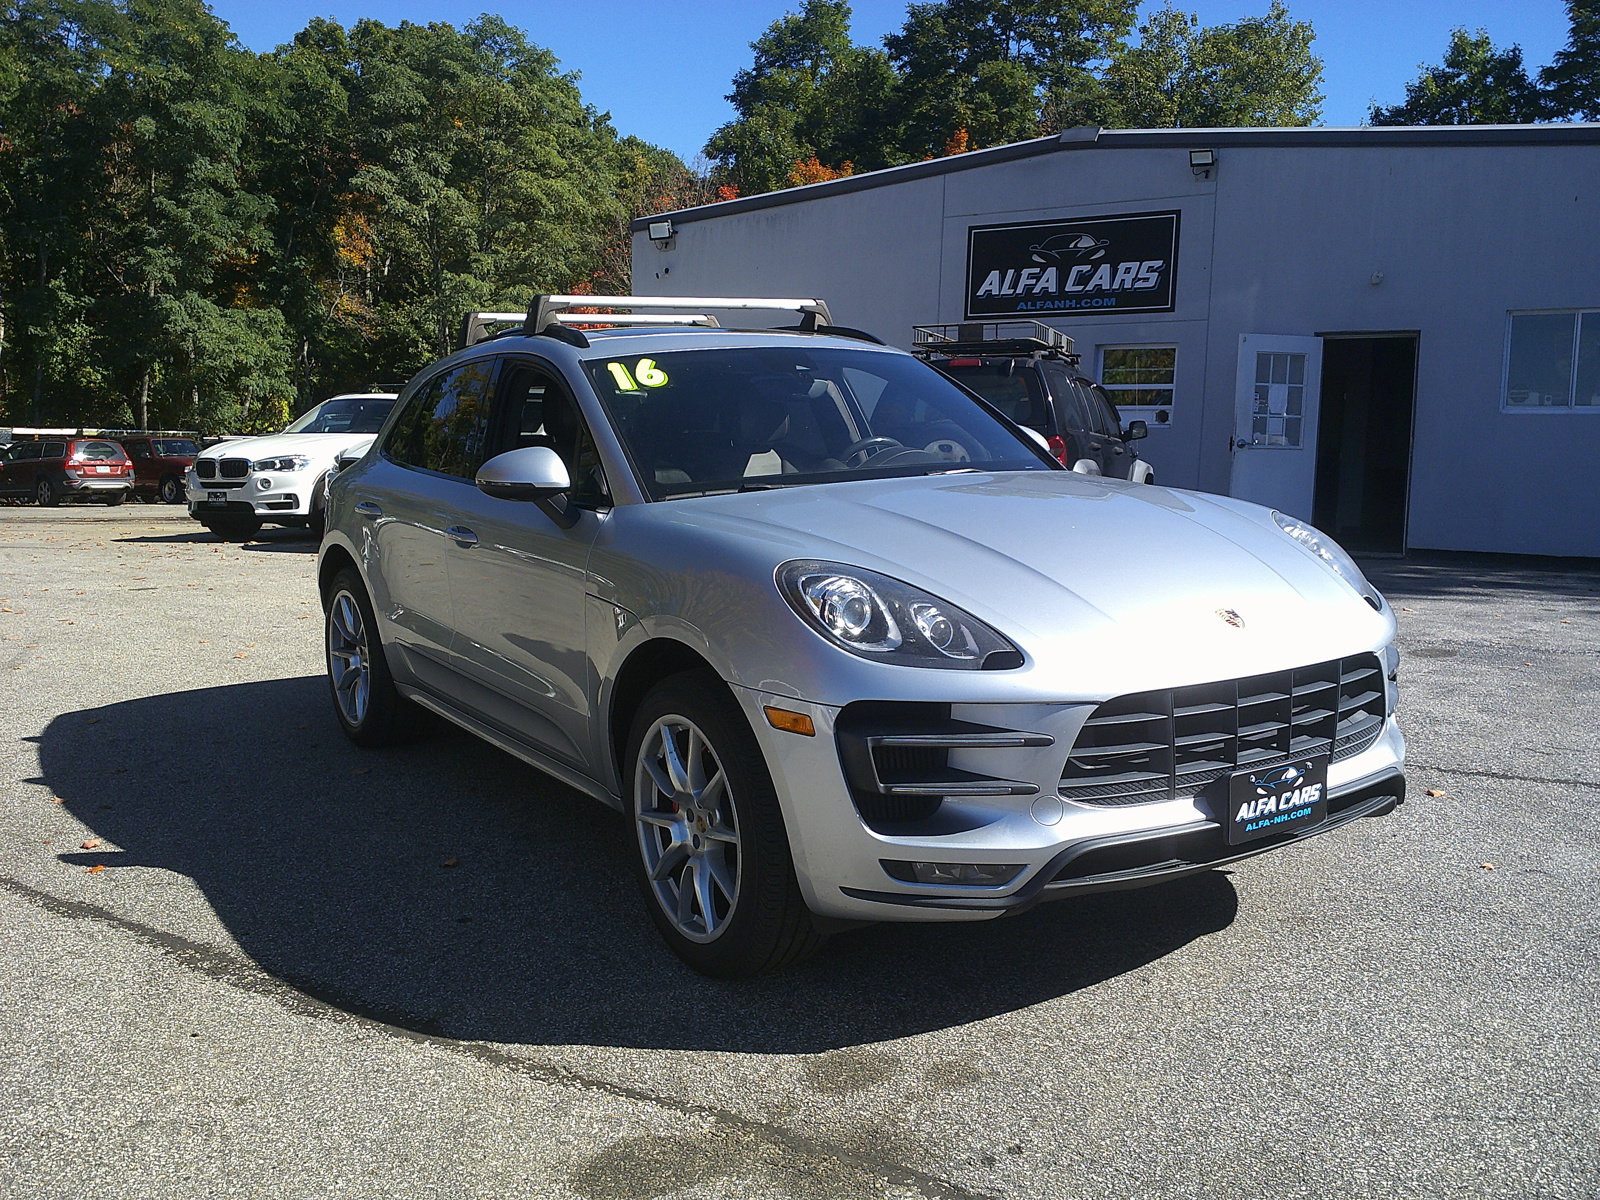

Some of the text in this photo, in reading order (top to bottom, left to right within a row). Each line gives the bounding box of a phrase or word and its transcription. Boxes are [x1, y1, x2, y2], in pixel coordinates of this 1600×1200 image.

[976, 260, 1165, 298] ALFA CARS
[1016, 297, 1117, 311] ALFANH.COM
[607, 358, 669, 391] 16
[1235, 783, 1322, 823] ALFA CARS
[1245, 807, 1312, 832] ALFA-NH.COM
